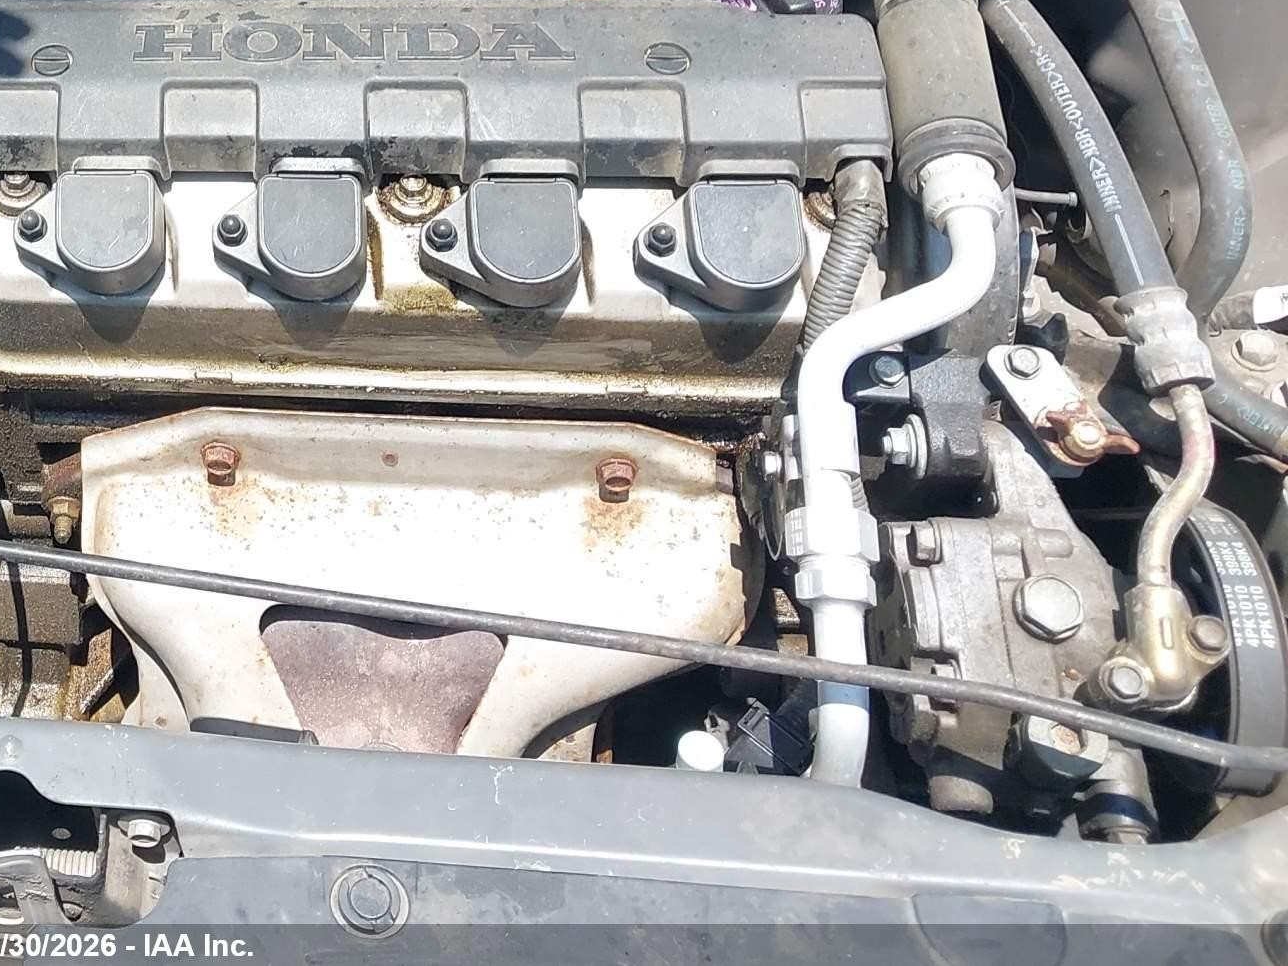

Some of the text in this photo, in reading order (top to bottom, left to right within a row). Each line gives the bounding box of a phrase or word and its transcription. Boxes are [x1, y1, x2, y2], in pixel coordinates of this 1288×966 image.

[133, 21, 576, 62] HONDA
[1234, 584, 1260, 648] 4PK1010
[1249, 584, 1277, 649] 4PK1010
